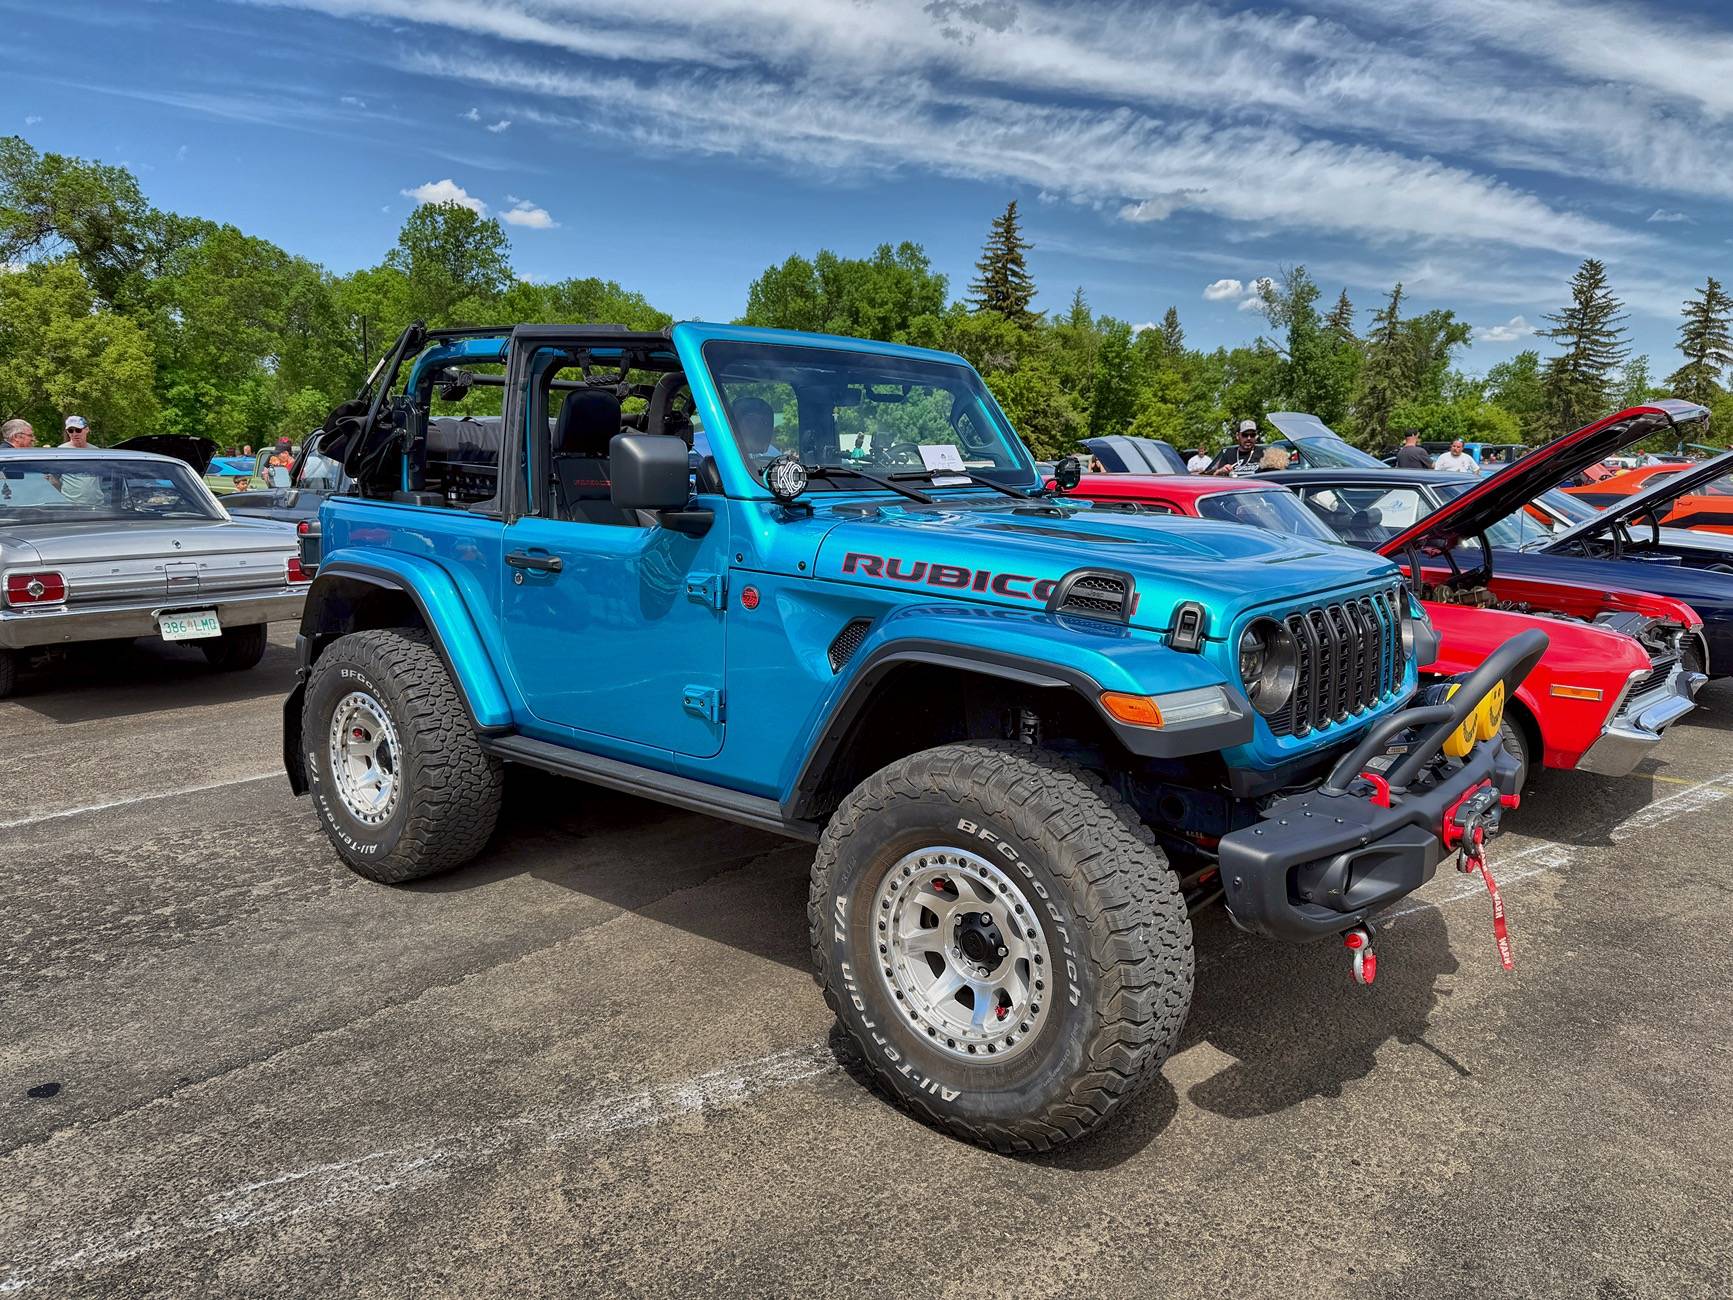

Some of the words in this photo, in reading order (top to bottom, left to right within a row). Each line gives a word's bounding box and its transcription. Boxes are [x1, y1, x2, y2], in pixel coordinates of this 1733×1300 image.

[777, 461, 803, 493] KC
[842, 552, 1140, 616] RUBIC
[163, 620, 187, 634] 386
[834, 895, 848, 943] T/A
[957, 818, 1081, 1007] BFGoodrich
[1492, 890, 1504, 919] WARN
[1499, 937, 1511, 965] WARN
[841, 962, 961, 1102] All-Terrain
